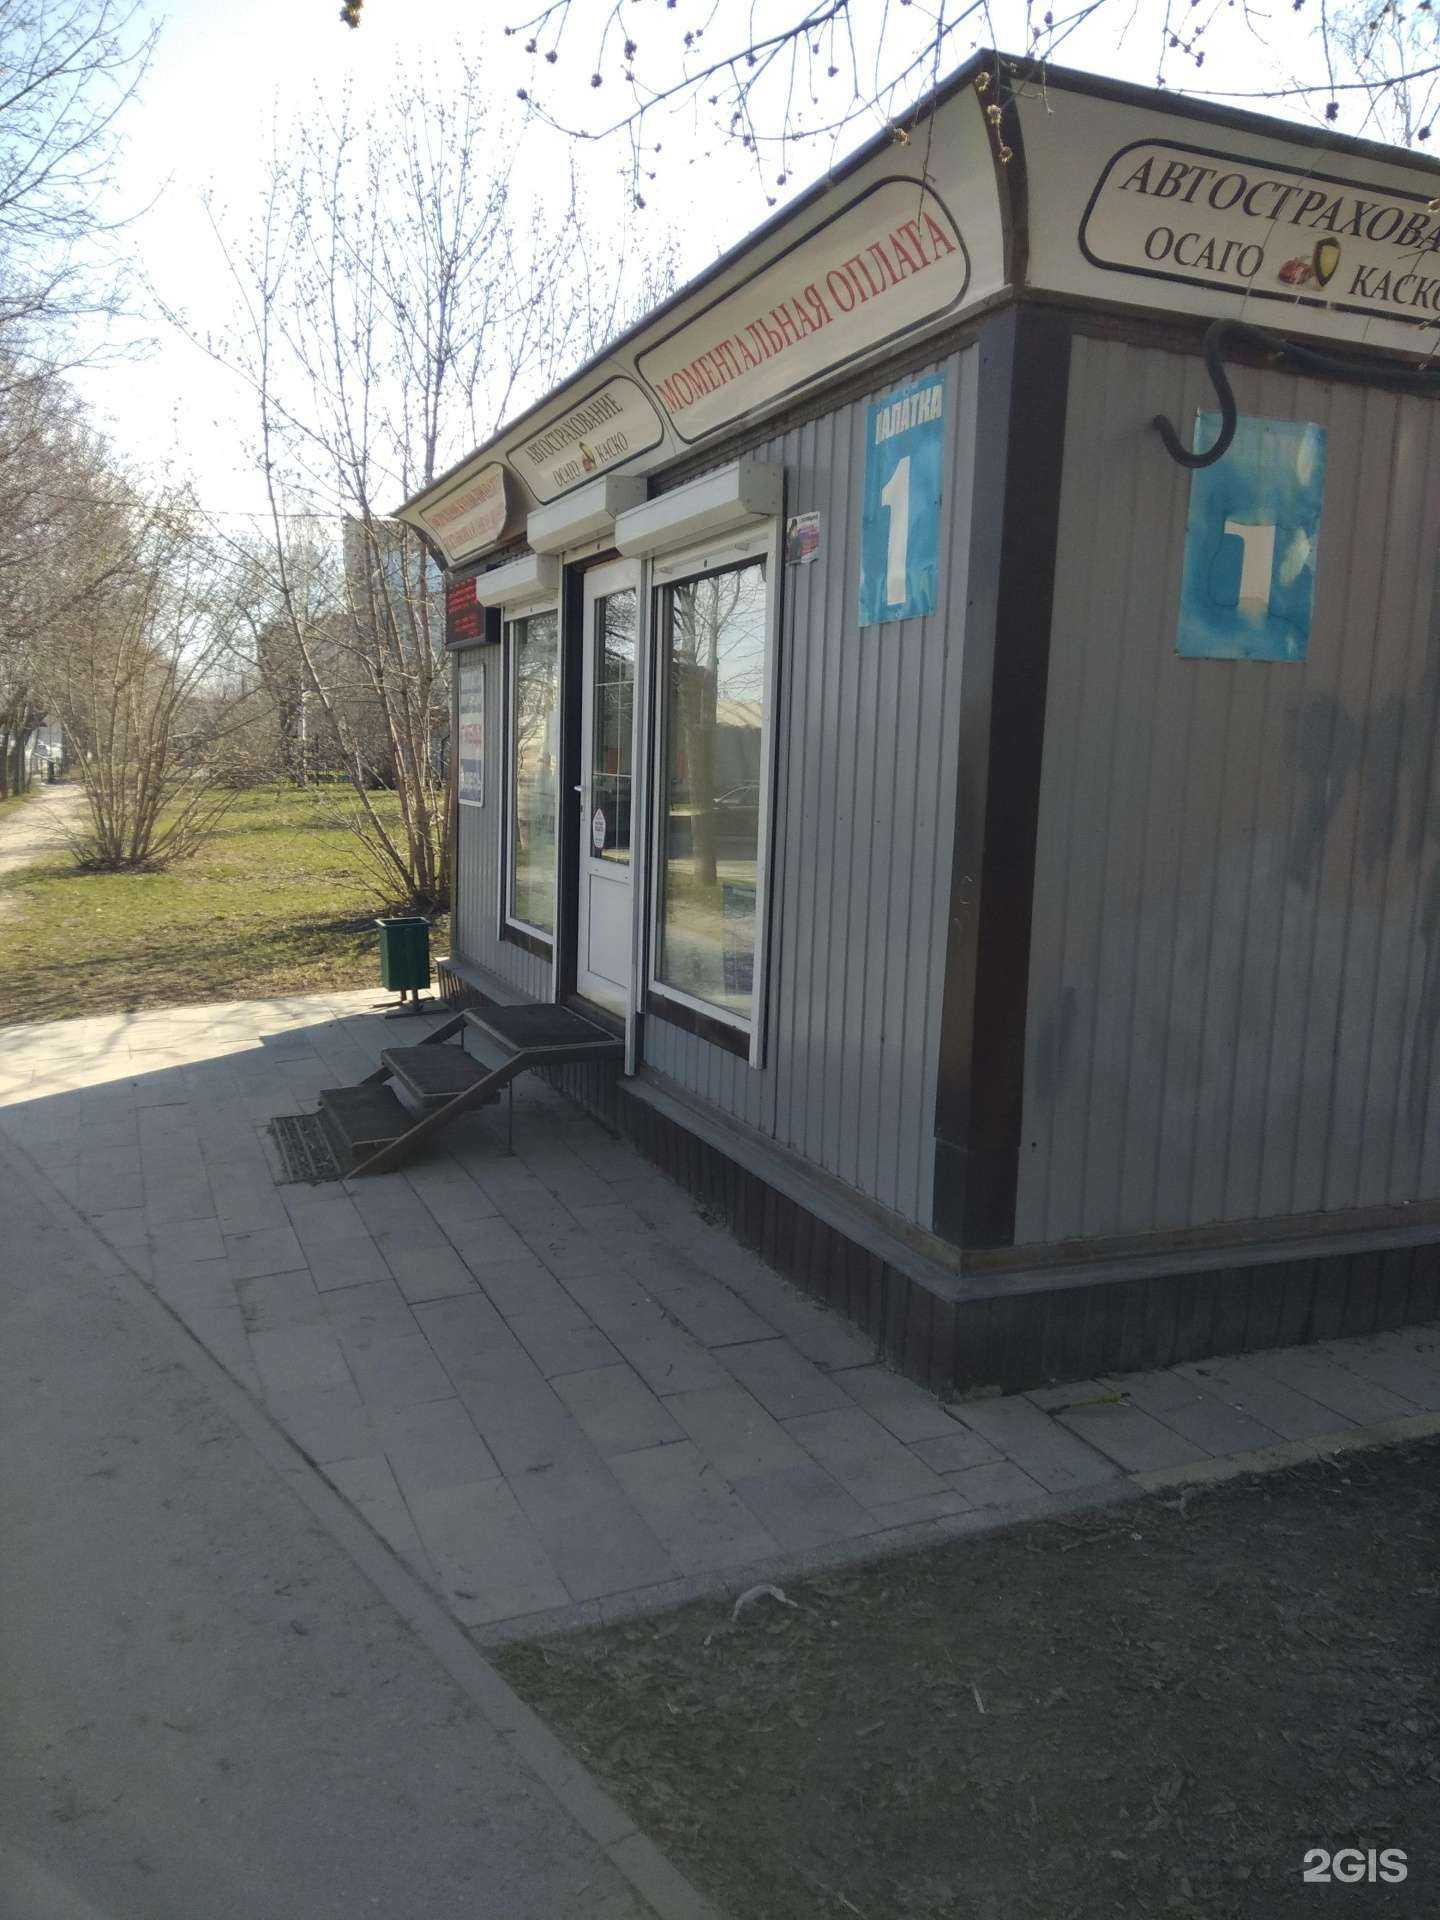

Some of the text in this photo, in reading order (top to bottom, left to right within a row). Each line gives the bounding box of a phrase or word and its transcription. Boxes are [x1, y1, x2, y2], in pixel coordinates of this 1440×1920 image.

[1144, 226, 1266, 279] ОСАГО
[655, 210, 957, 415] МОМЕНТАЛЬНАЯ ОПЛАТА
[525, 392, 624, 466] АВТОСТРАХОВАНИЕ
[594, 431, 630, 464] КАСКО
[881, 455, 911, 605] 1
